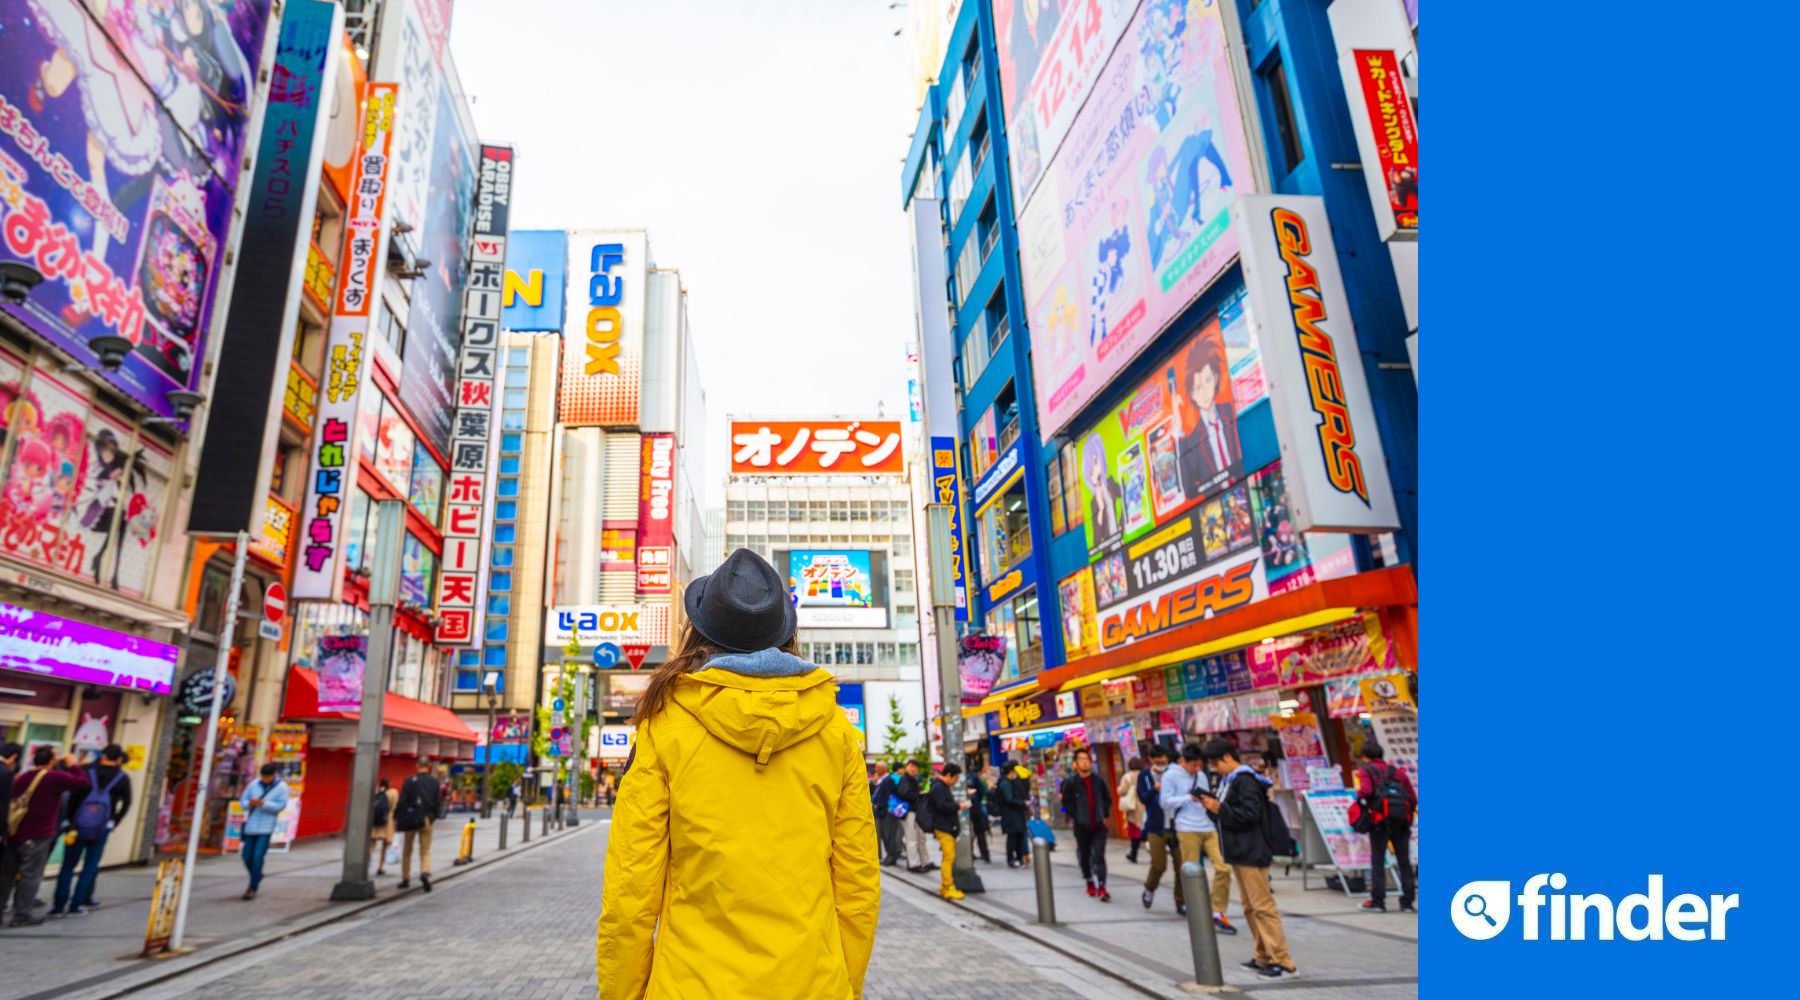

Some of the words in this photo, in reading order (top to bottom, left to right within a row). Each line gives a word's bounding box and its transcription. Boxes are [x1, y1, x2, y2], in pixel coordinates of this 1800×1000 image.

[1270, 206, 1372, 509] GAMERS
[651, 438, 672, 478] Duty
[733, 422, 901, 467] オノデン
[304, 417, 347, 573] とれじゃらす
[650, 480, 672, 519] Free
[1133, 543, 1180, 589] 11.30
[1101, 558, 1260, 650] GAMERS
[602, 733, 637, 746] La
